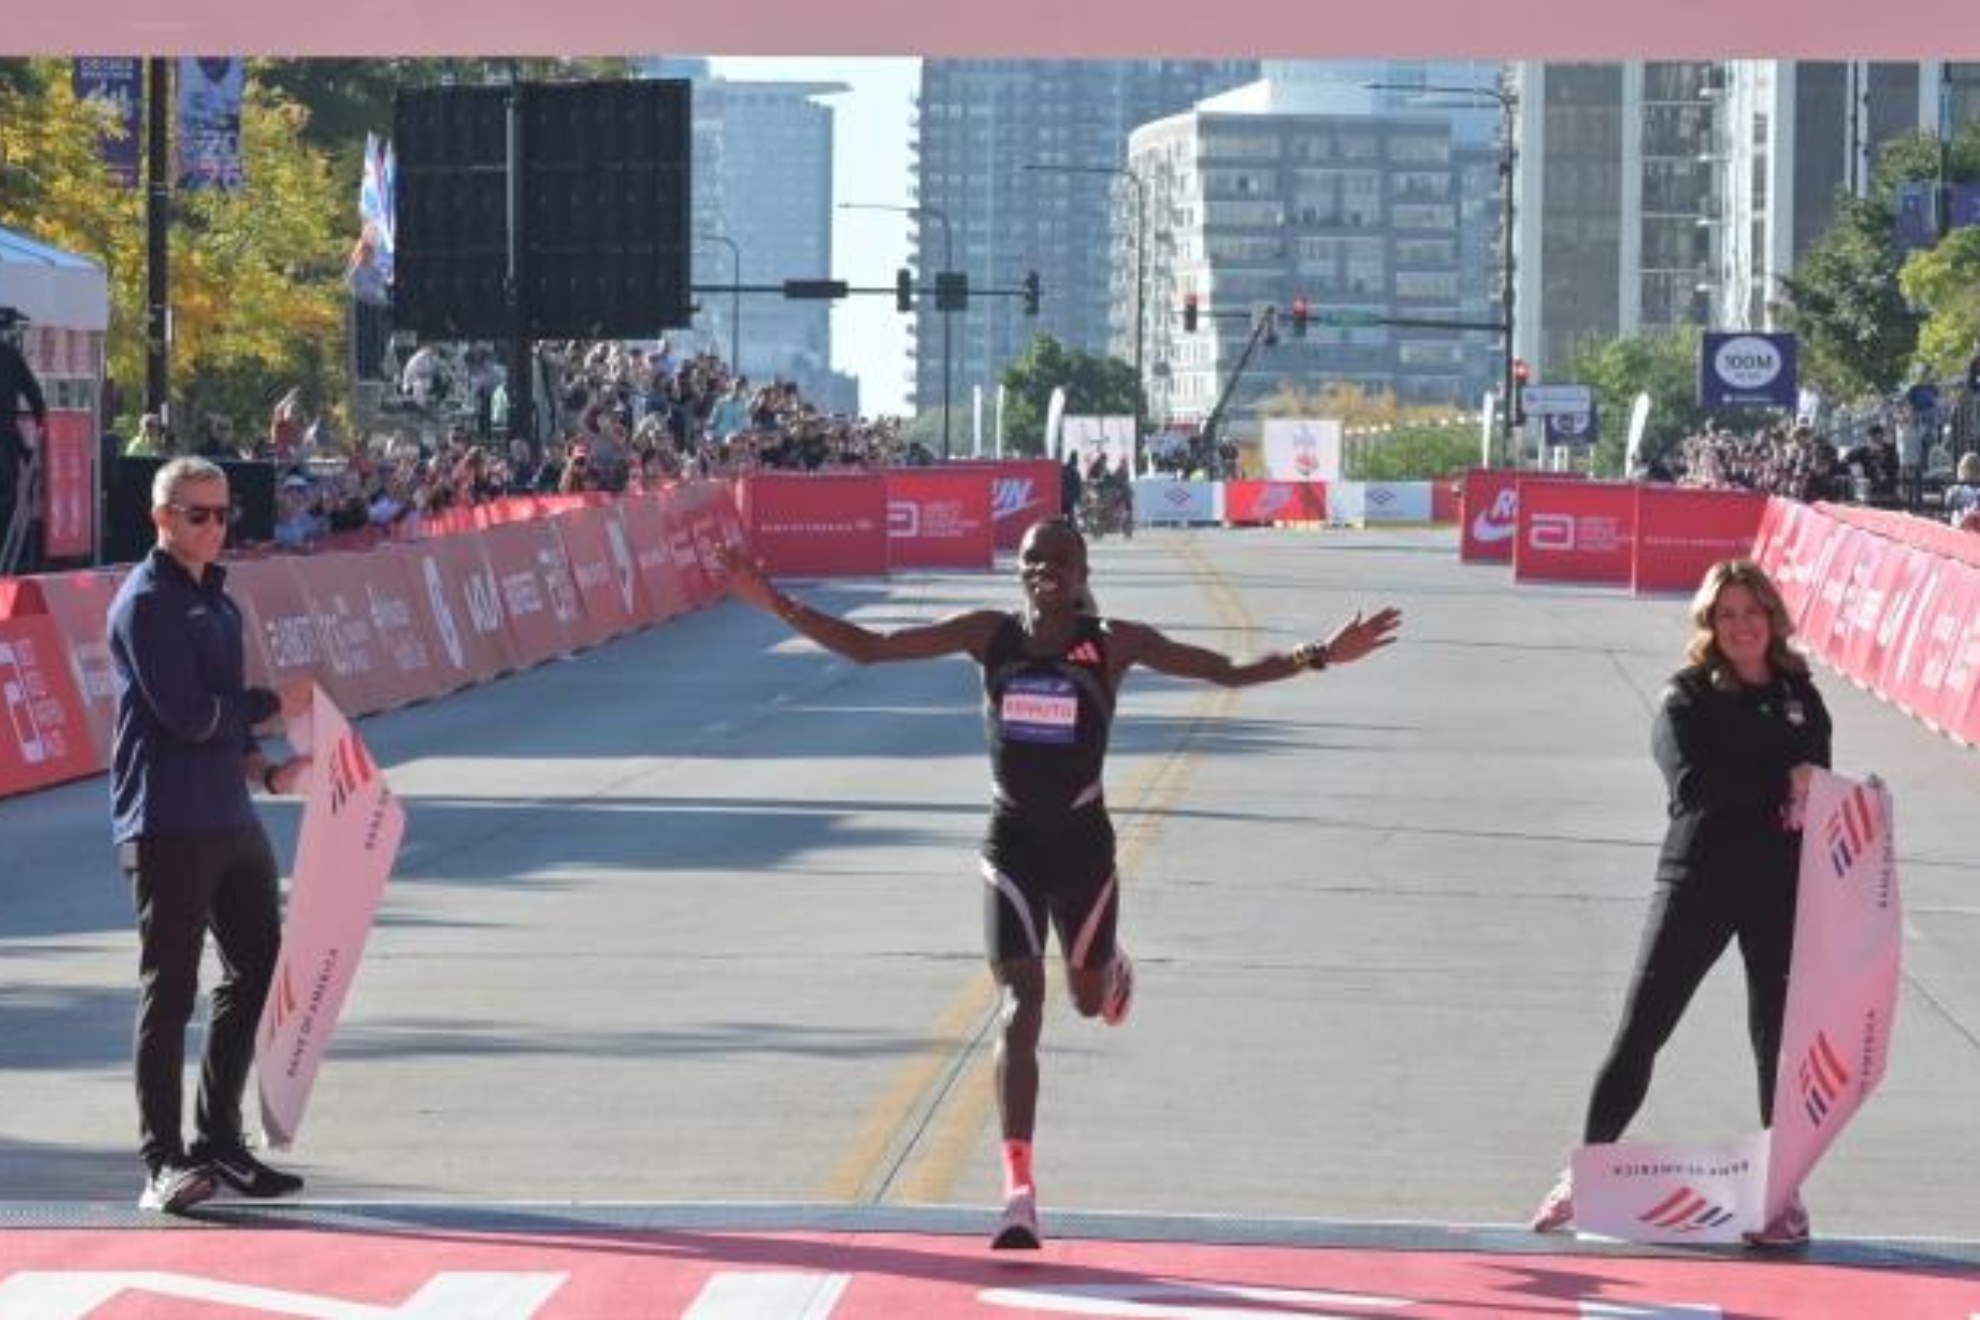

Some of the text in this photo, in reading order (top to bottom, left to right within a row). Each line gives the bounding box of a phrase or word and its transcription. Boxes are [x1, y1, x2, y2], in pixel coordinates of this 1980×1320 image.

[1724, 355, 1772, 370] 100M
[287, 1037, 306, 1077] BANK
[309, 948, 338, 1013] AMERICA
[1613, 1164, 1682, 1176] AMERICA
[1709, 1159, 1749, 1176] BANK
